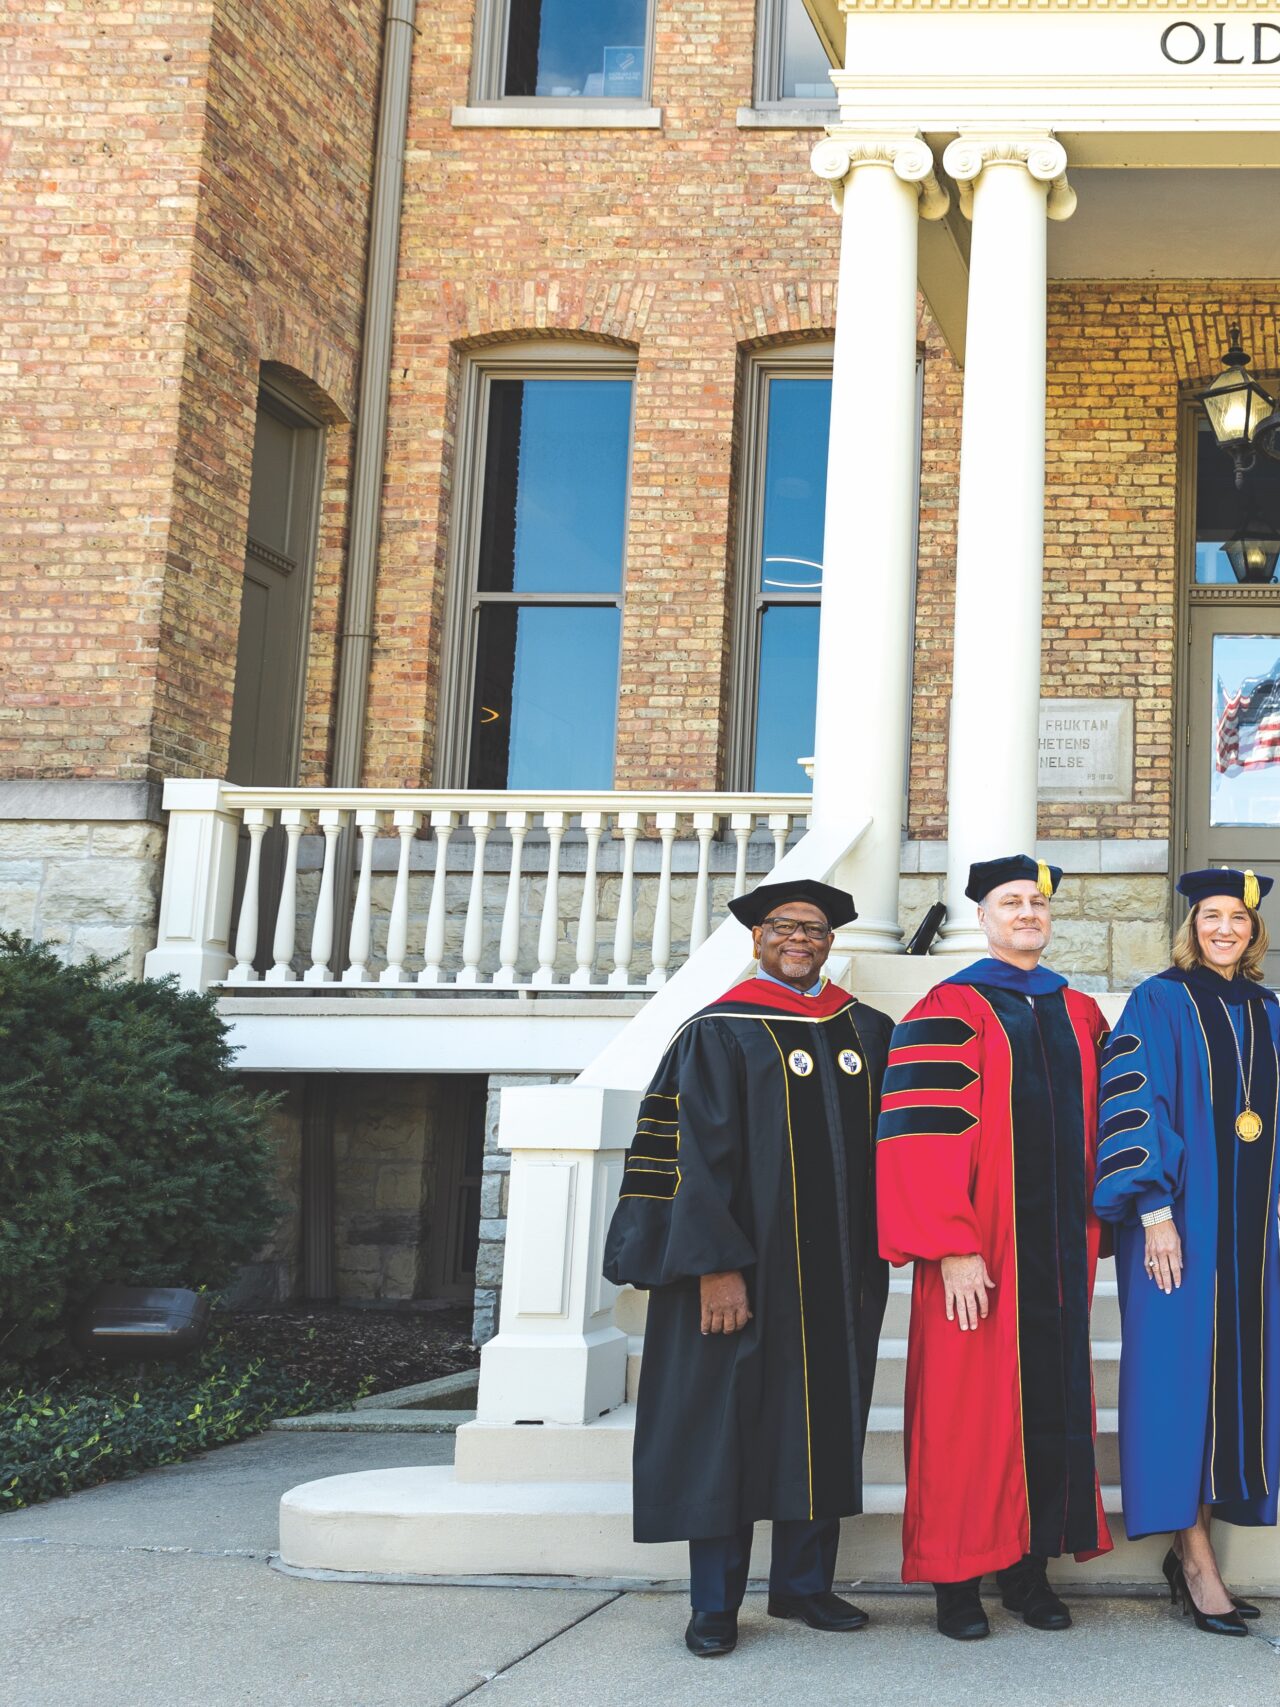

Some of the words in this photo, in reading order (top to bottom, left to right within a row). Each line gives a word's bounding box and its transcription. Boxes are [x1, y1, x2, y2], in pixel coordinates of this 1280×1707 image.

[1045, 720, 1109, 731] FRUKTAN
[1038, 738, 1090, 750] HETENS
[1039, 757, 1084, 768] NELSE
